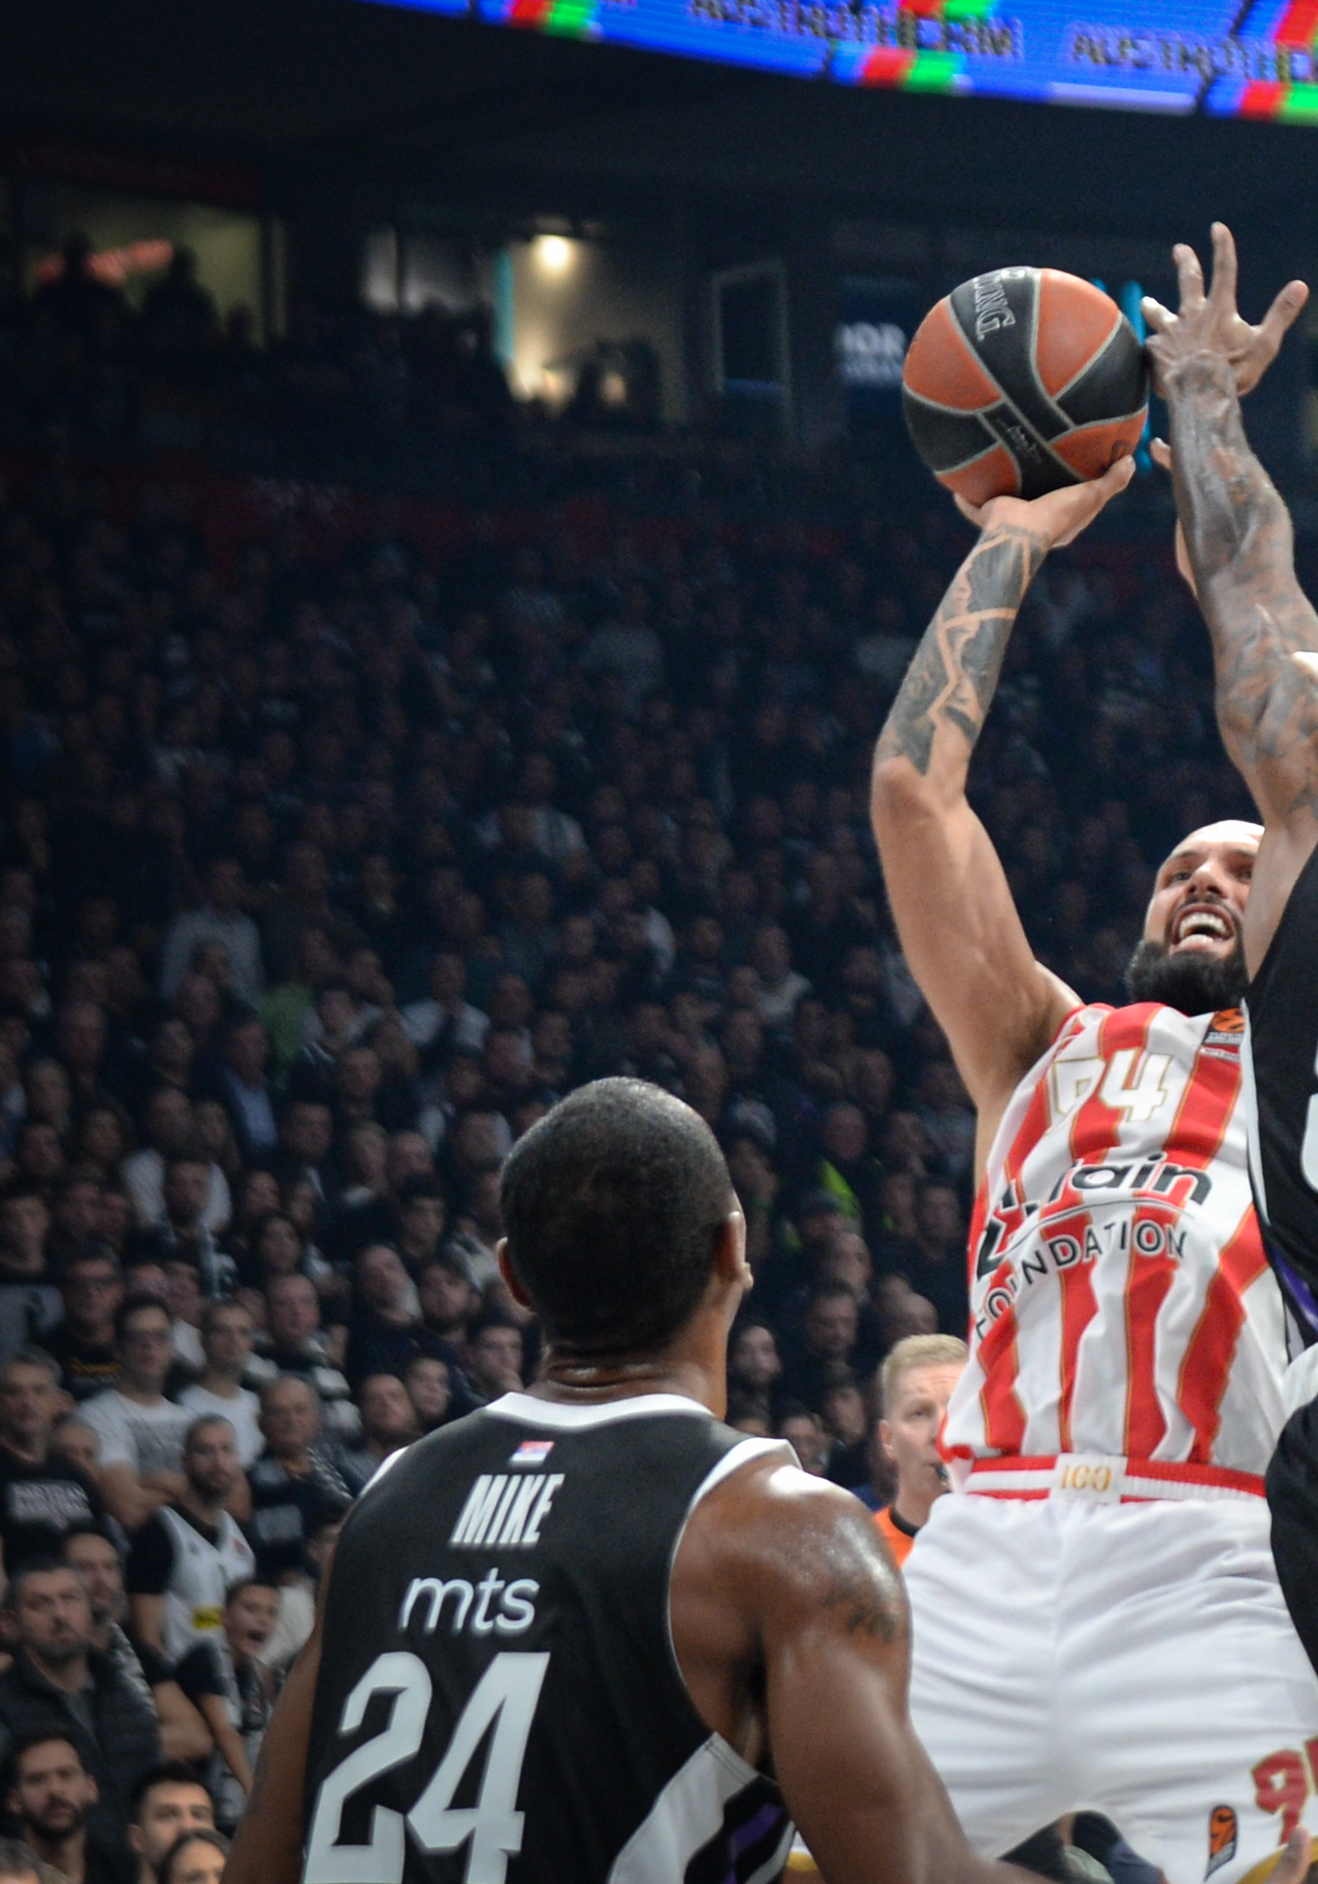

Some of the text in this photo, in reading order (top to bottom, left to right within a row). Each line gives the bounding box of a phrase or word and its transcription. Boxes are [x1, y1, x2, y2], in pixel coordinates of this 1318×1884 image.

[450, 1473, 566, 1549] MIKE
[400, 1567, 542, 1635] mts
[302, 1650, 552, 1884] 24
